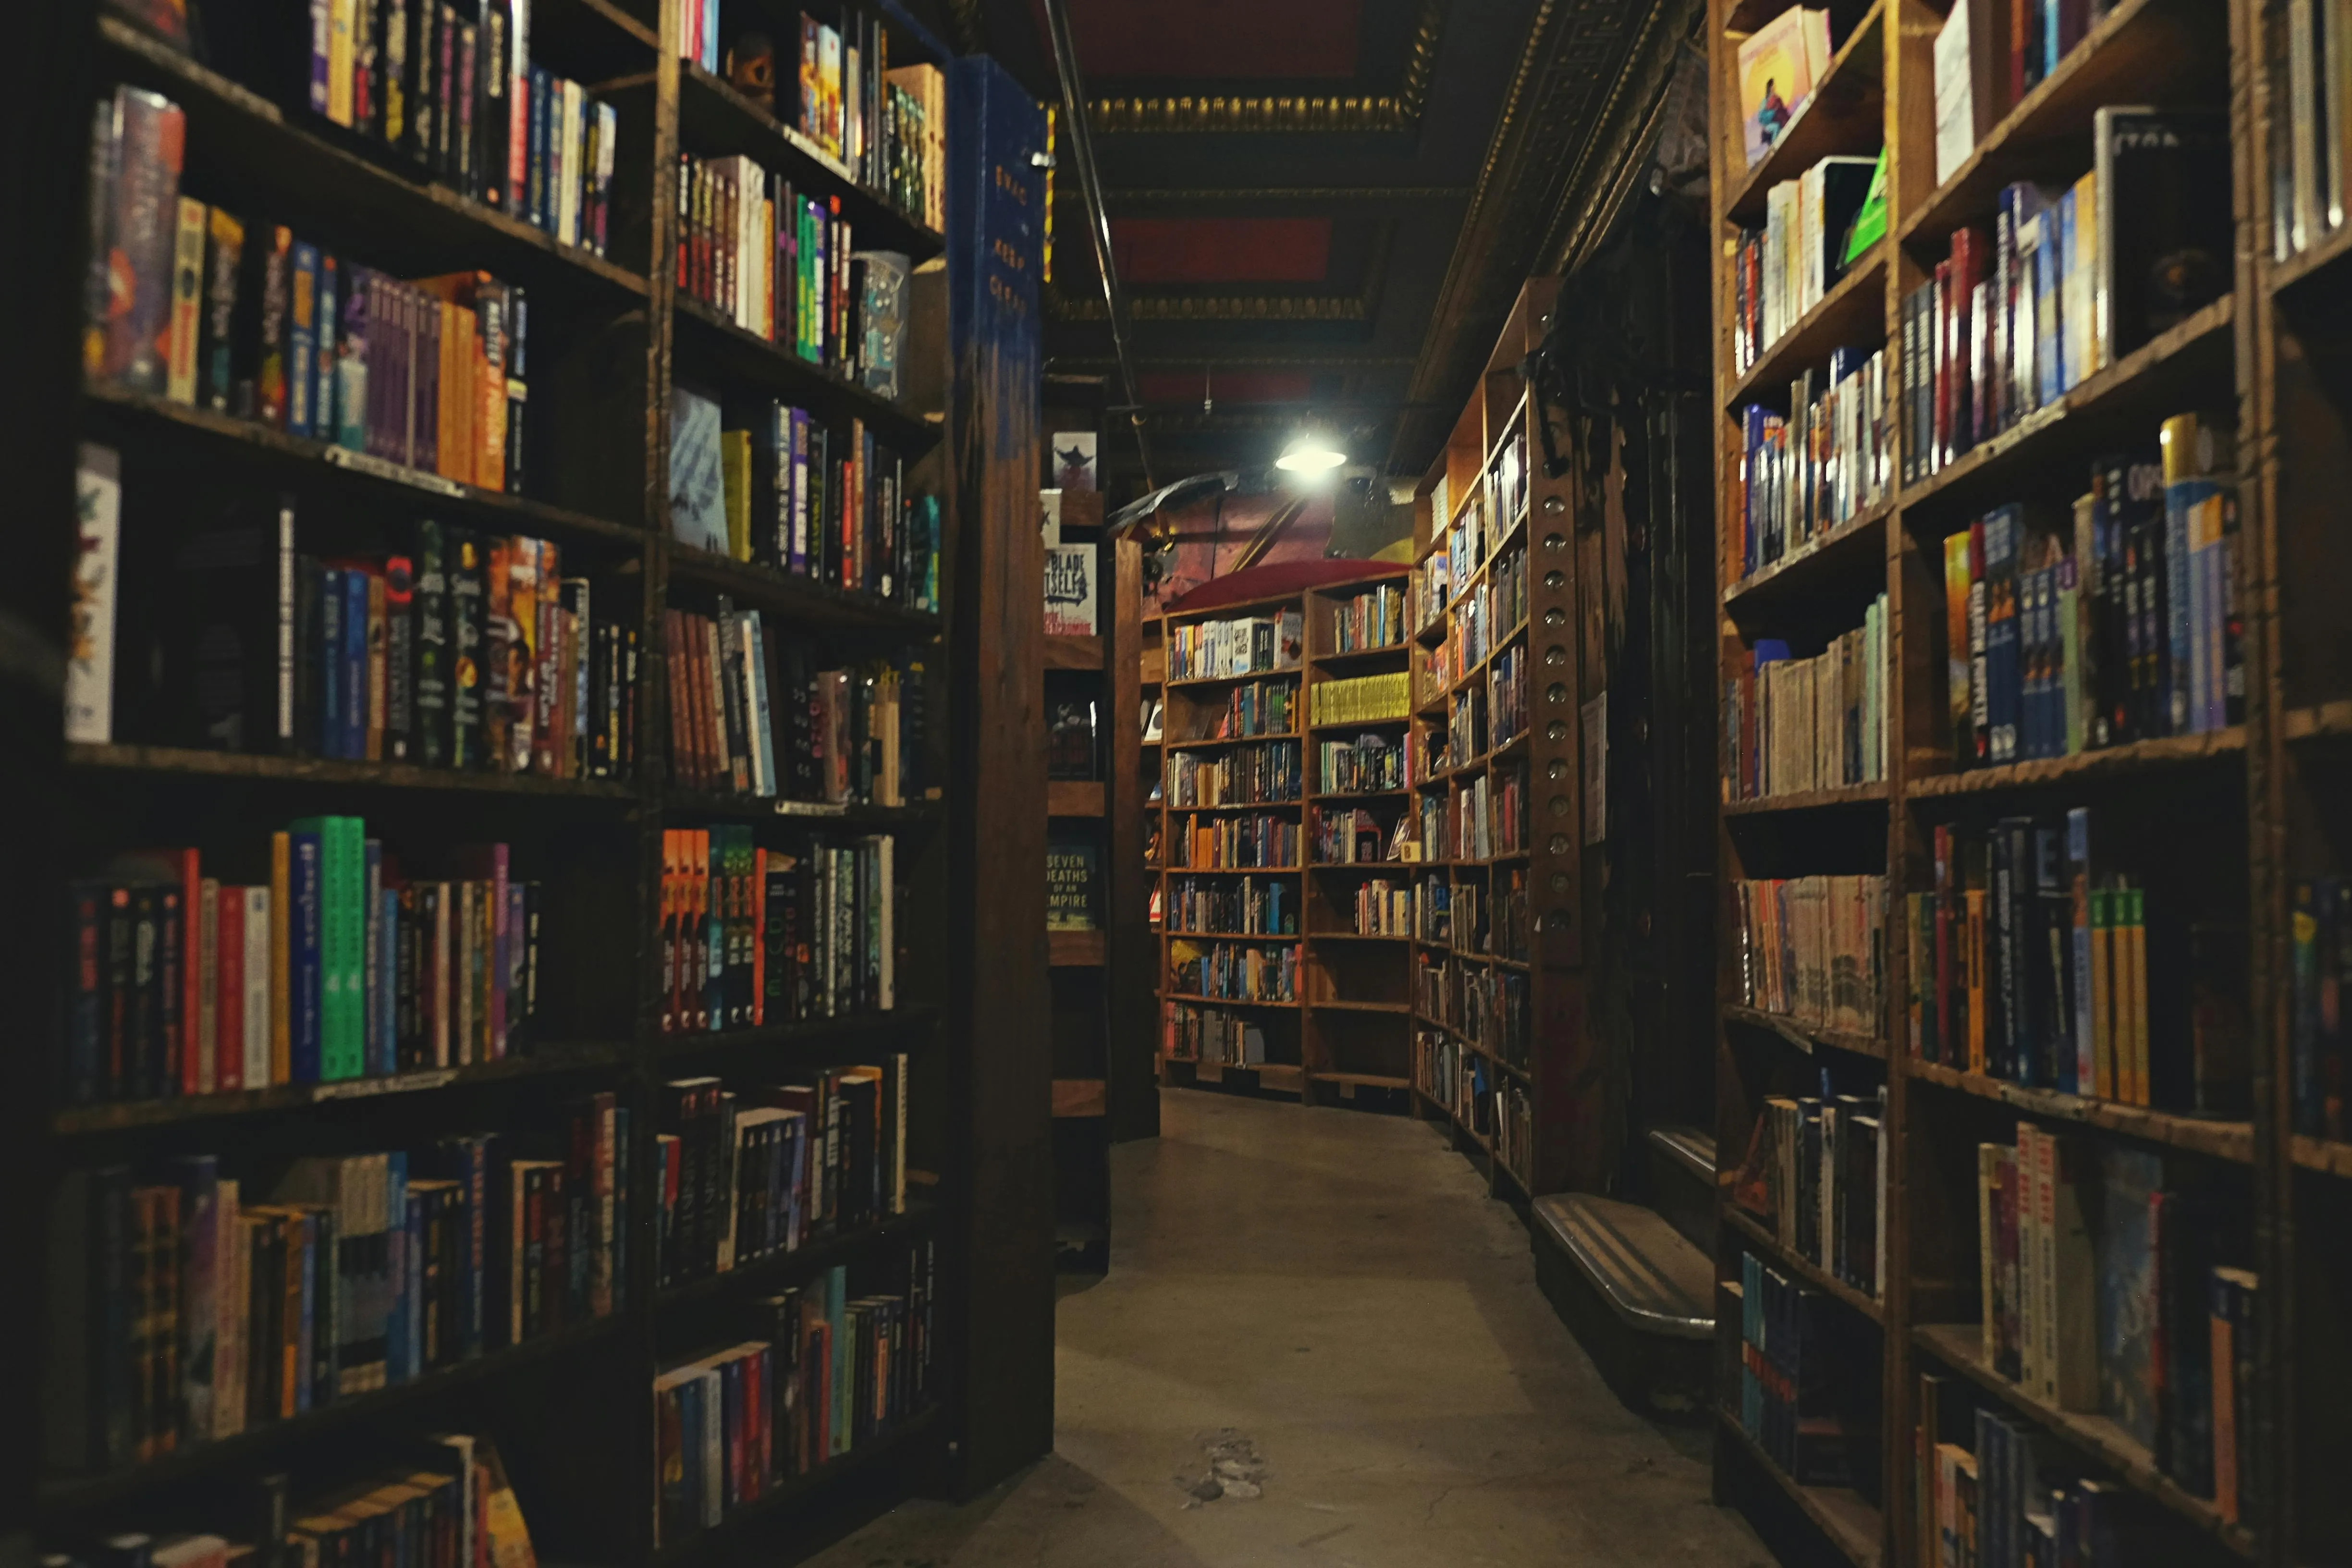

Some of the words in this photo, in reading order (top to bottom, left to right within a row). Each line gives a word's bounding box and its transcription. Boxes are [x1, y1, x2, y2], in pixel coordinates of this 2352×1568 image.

[1051, 554, 1084, 573] BLADE
[1045, 573, 1079, 594] TSELF
[1046, 854, 1084, 869] SEVEN
[1047, 894, 1088, 908] MPIRE
